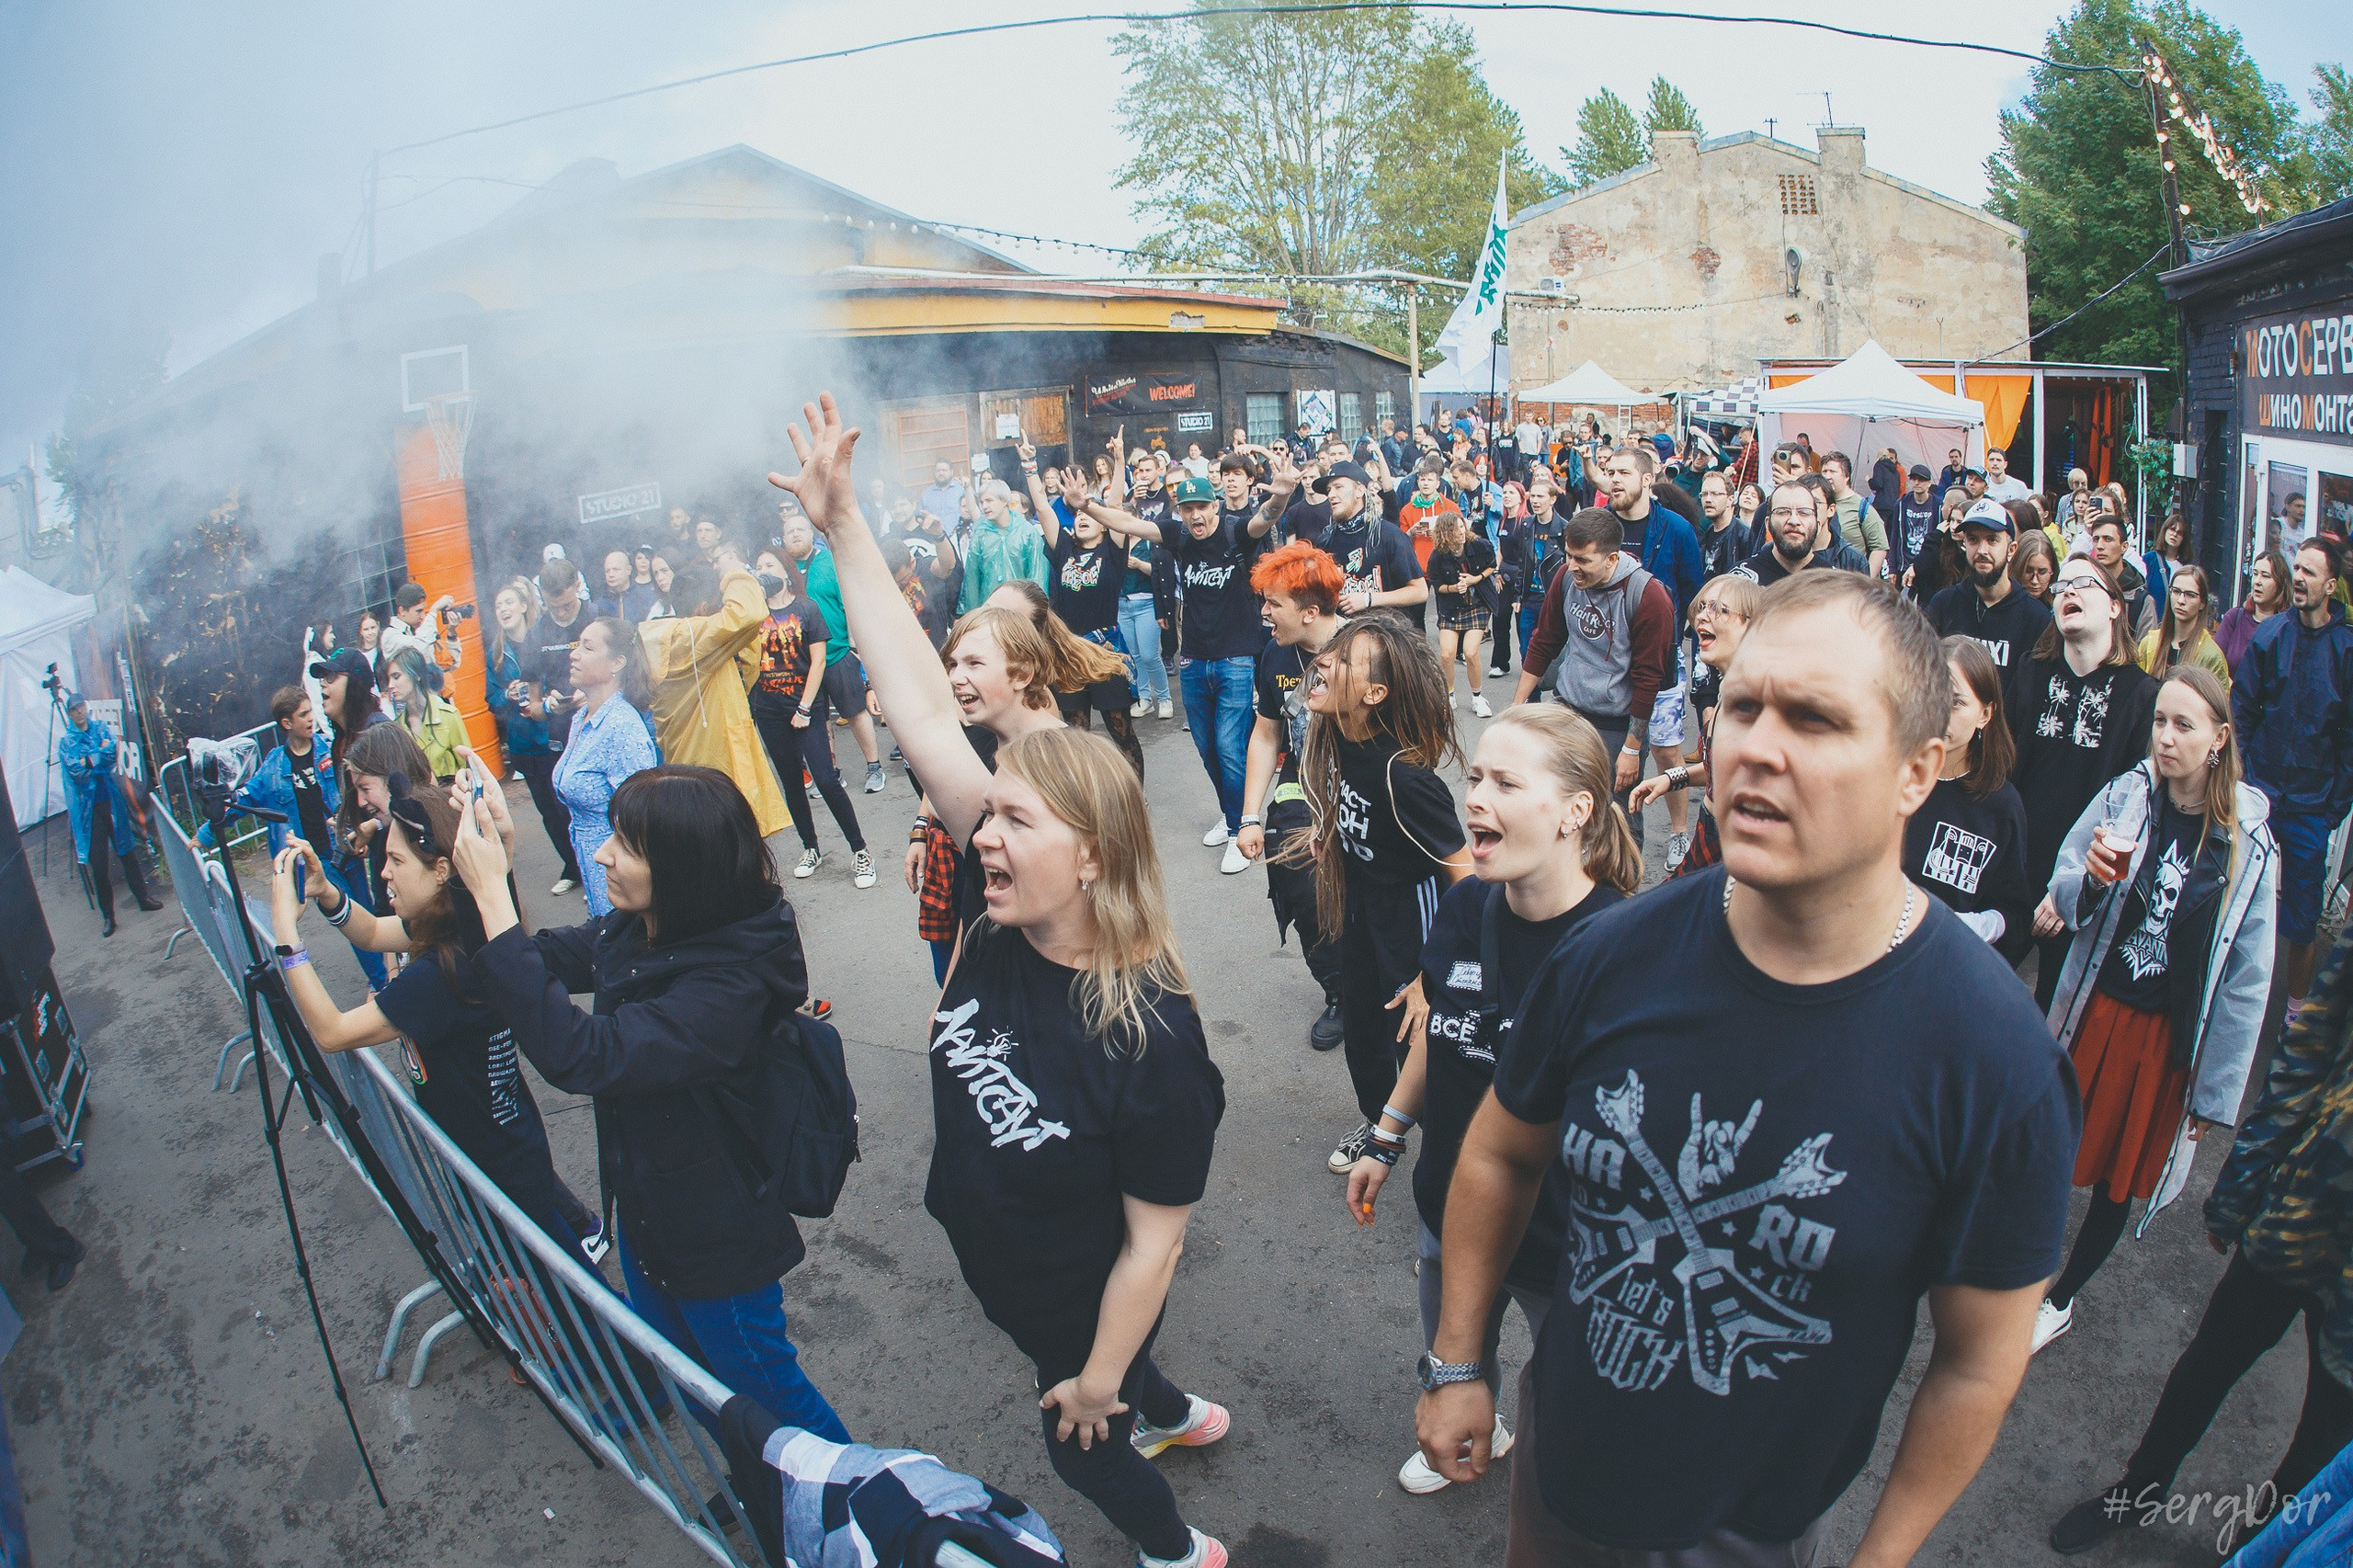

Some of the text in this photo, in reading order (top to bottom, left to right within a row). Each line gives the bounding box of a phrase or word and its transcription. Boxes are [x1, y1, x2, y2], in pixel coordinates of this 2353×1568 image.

[1149, 382, 1196, 401] WELCOME!
[1180, 416, 1203, 427] STUDIO
[1583, 626, 1597, 635] CAFE
